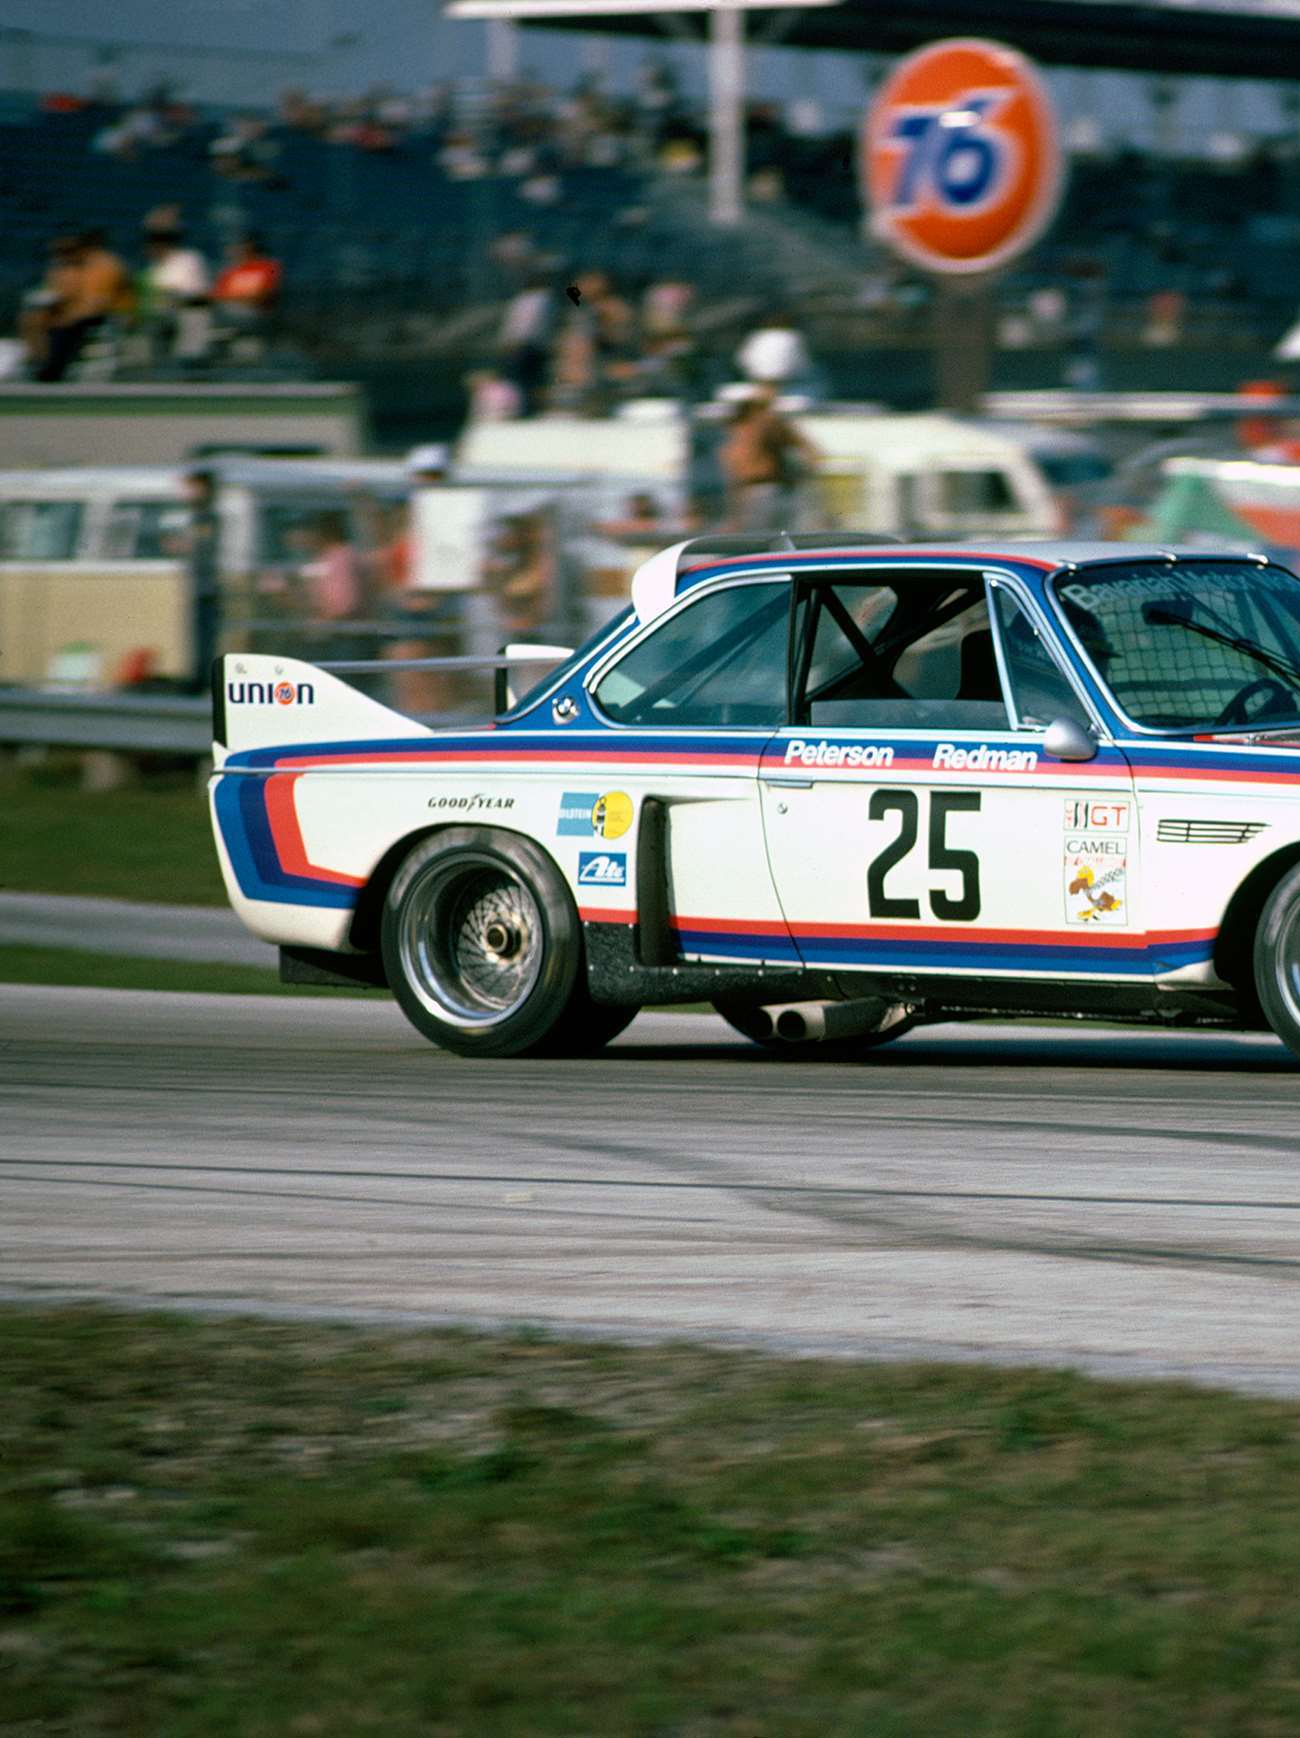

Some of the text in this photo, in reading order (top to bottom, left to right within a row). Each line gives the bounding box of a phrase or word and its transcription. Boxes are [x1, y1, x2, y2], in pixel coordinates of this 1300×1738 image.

[886, 92, 1000, 208] 76
[784, 740, 1038, 771] Peterson Redman
[428, 794, 515, 811] GOODYEAR
[1091, 805, 1127, 826] GT
[867, 788, 982, 922] 25
[1067, 840, 1124, 855] CAMEL
